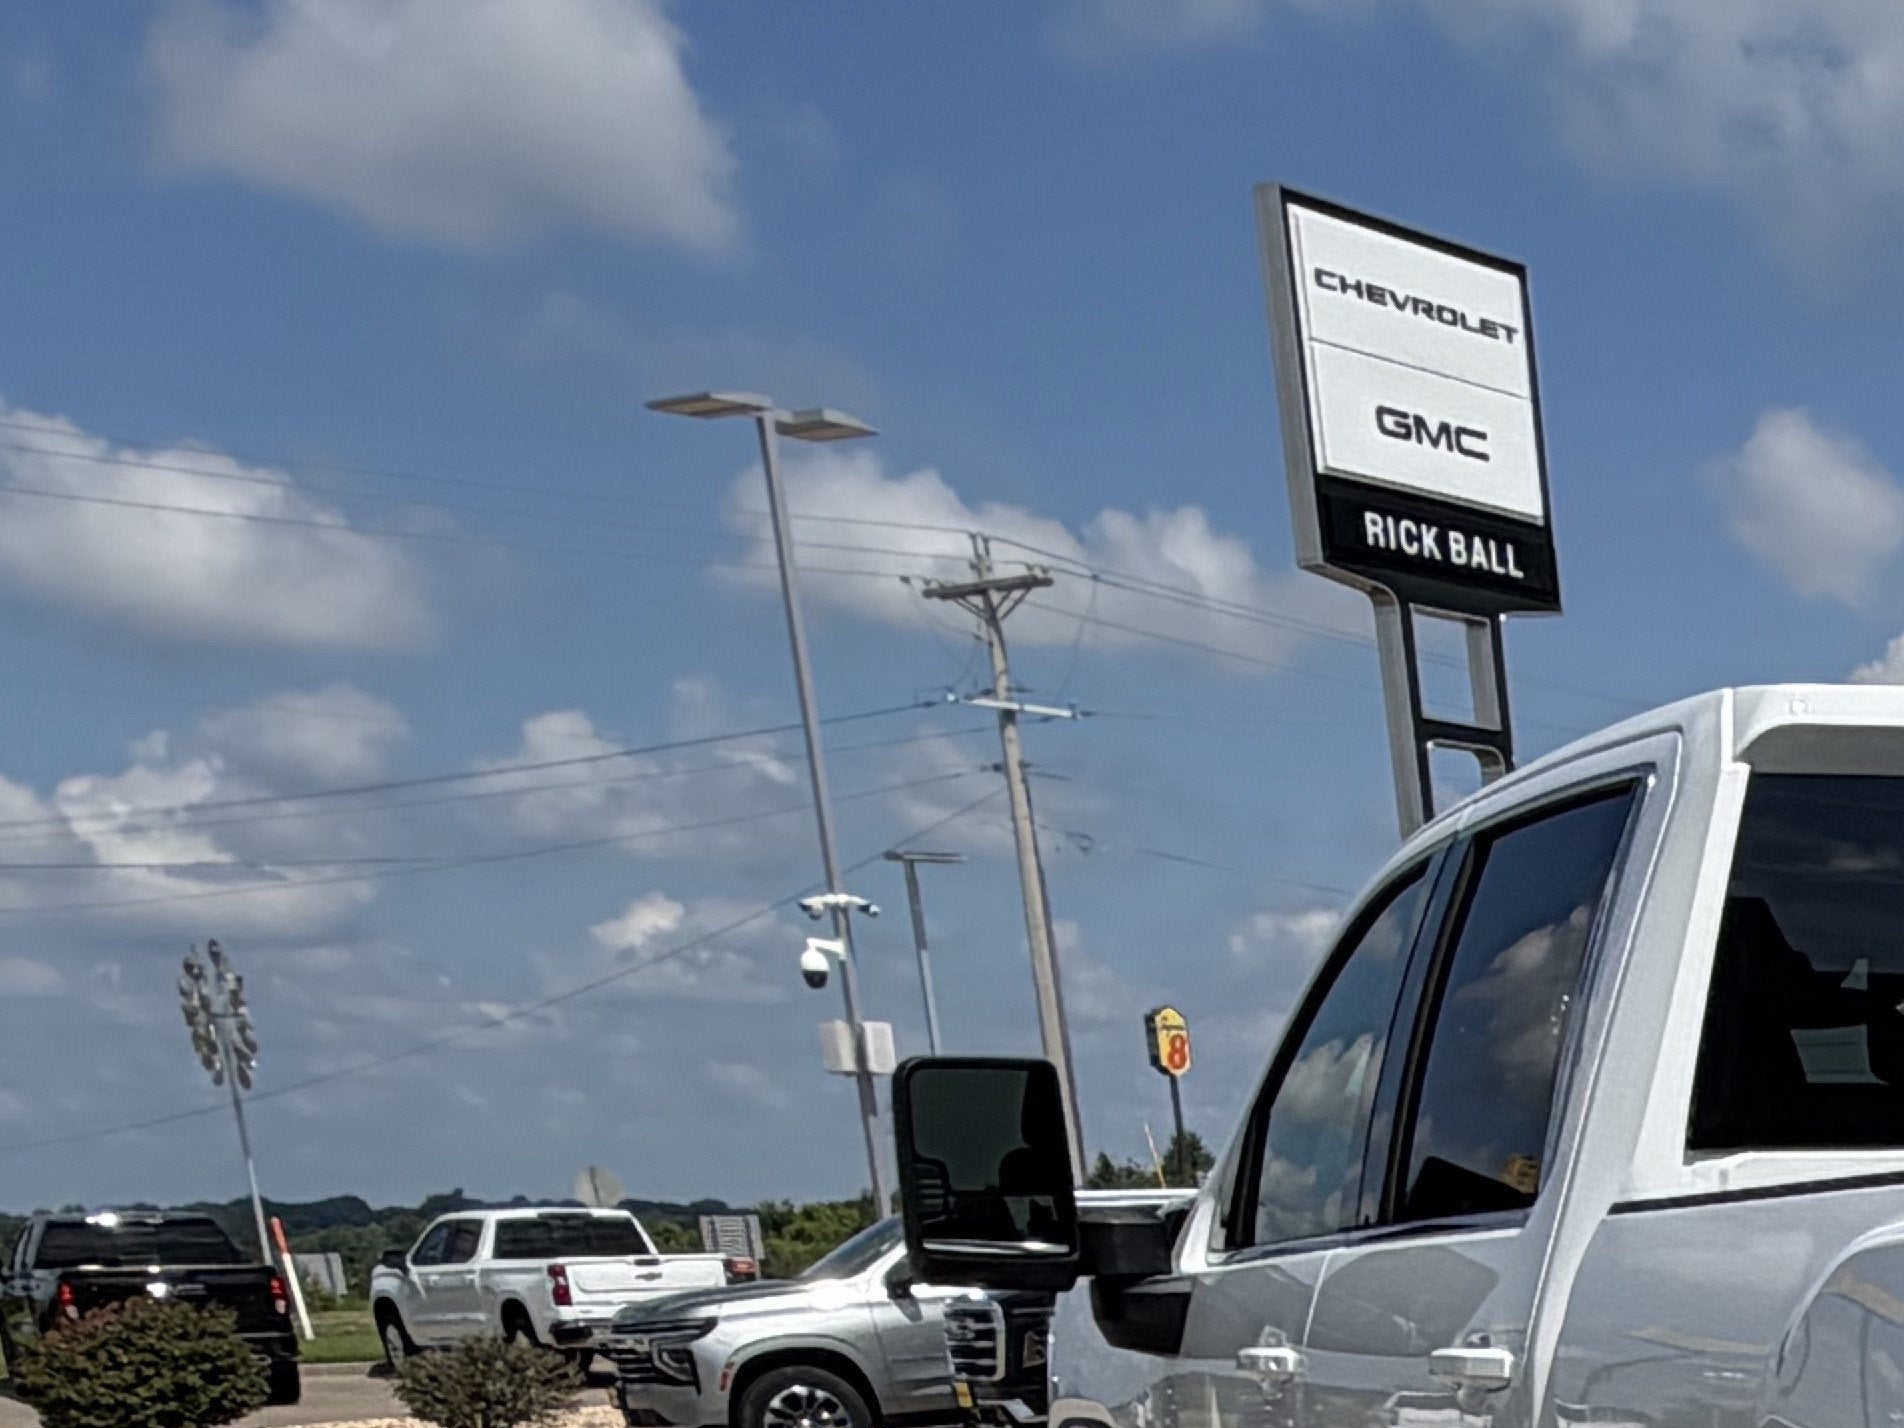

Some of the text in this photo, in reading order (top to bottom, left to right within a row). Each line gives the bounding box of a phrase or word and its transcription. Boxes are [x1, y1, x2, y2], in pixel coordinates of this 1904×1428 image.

[1314, 267, 1519, 344] CHEVROLET
[1374, 405, 1490, 462] GMC
[1364, 511, 1525, 579] RICK BALL
[1168, 1033, 1188, 1070] 8
